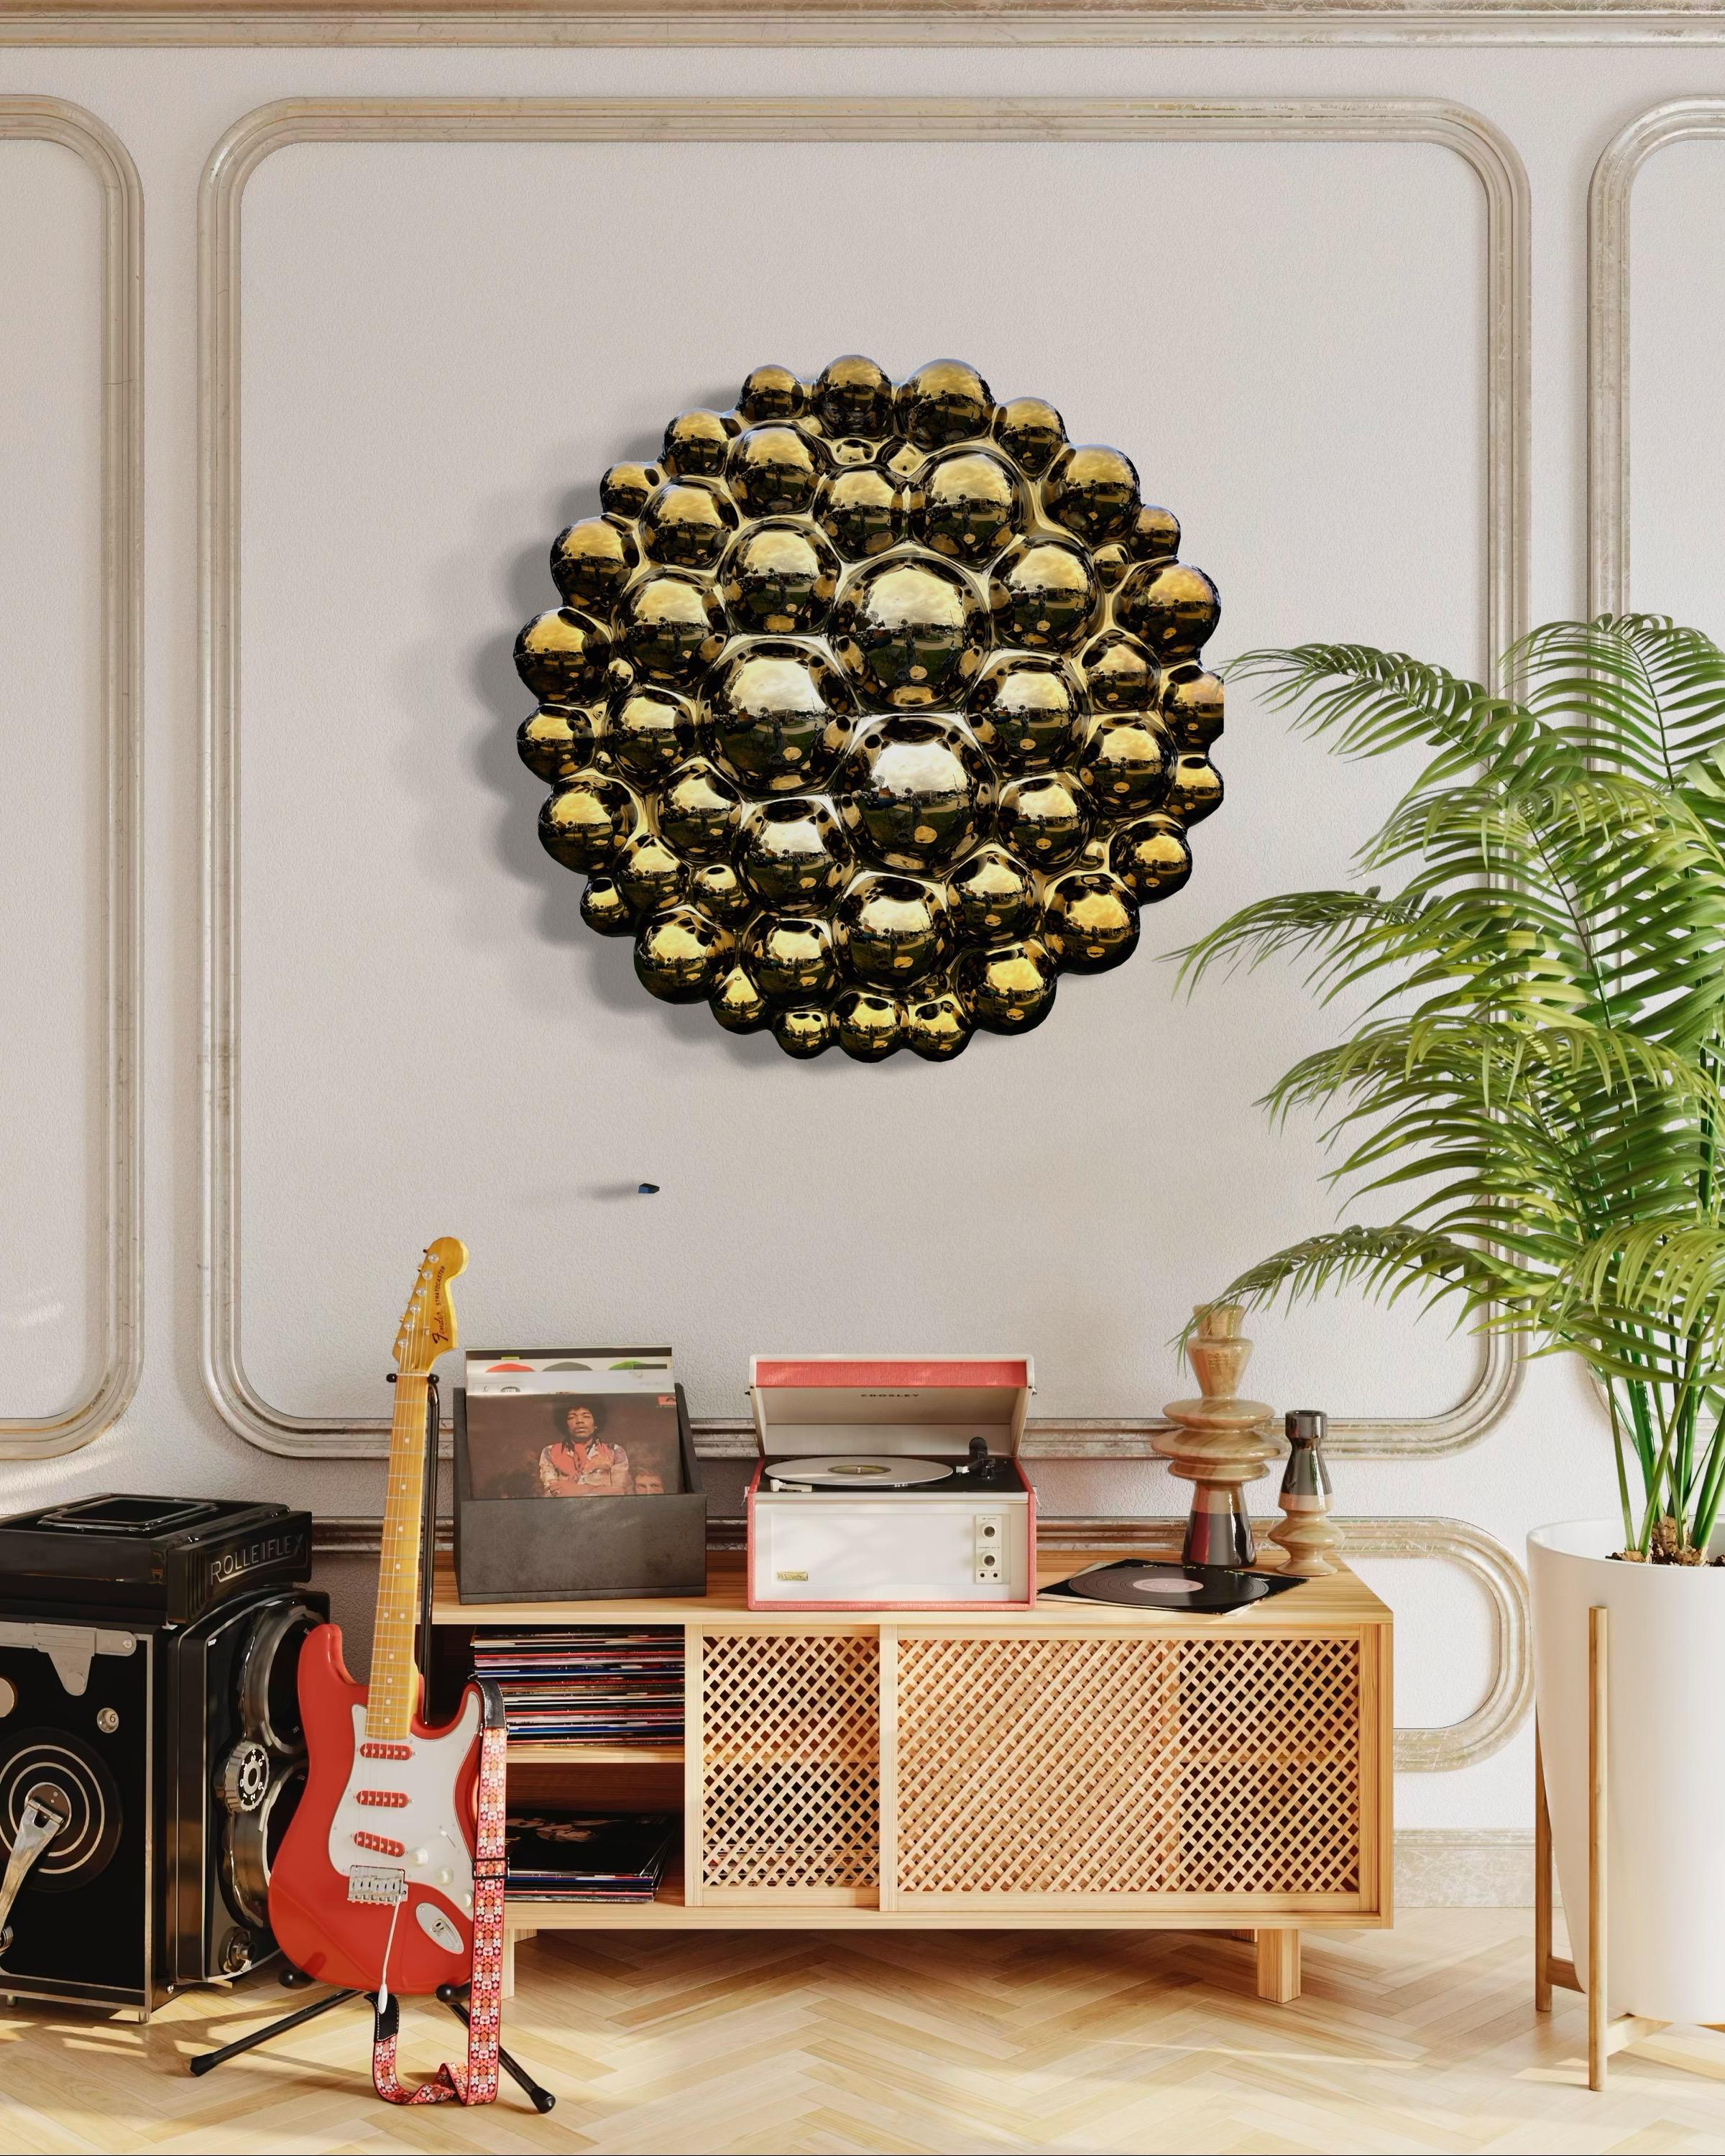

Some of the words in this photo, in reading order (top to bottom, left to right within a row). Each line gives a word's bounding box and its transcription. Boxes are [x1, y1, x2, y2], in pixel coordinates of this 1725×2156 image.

[435, 1265, 446, 1306] STRATOCASTER
[432, 1310, 448, 1345] Fender
[211, 1533, 304, 1585] ROLLEIFLEX
[109, 1713, 116, 1723] 6
